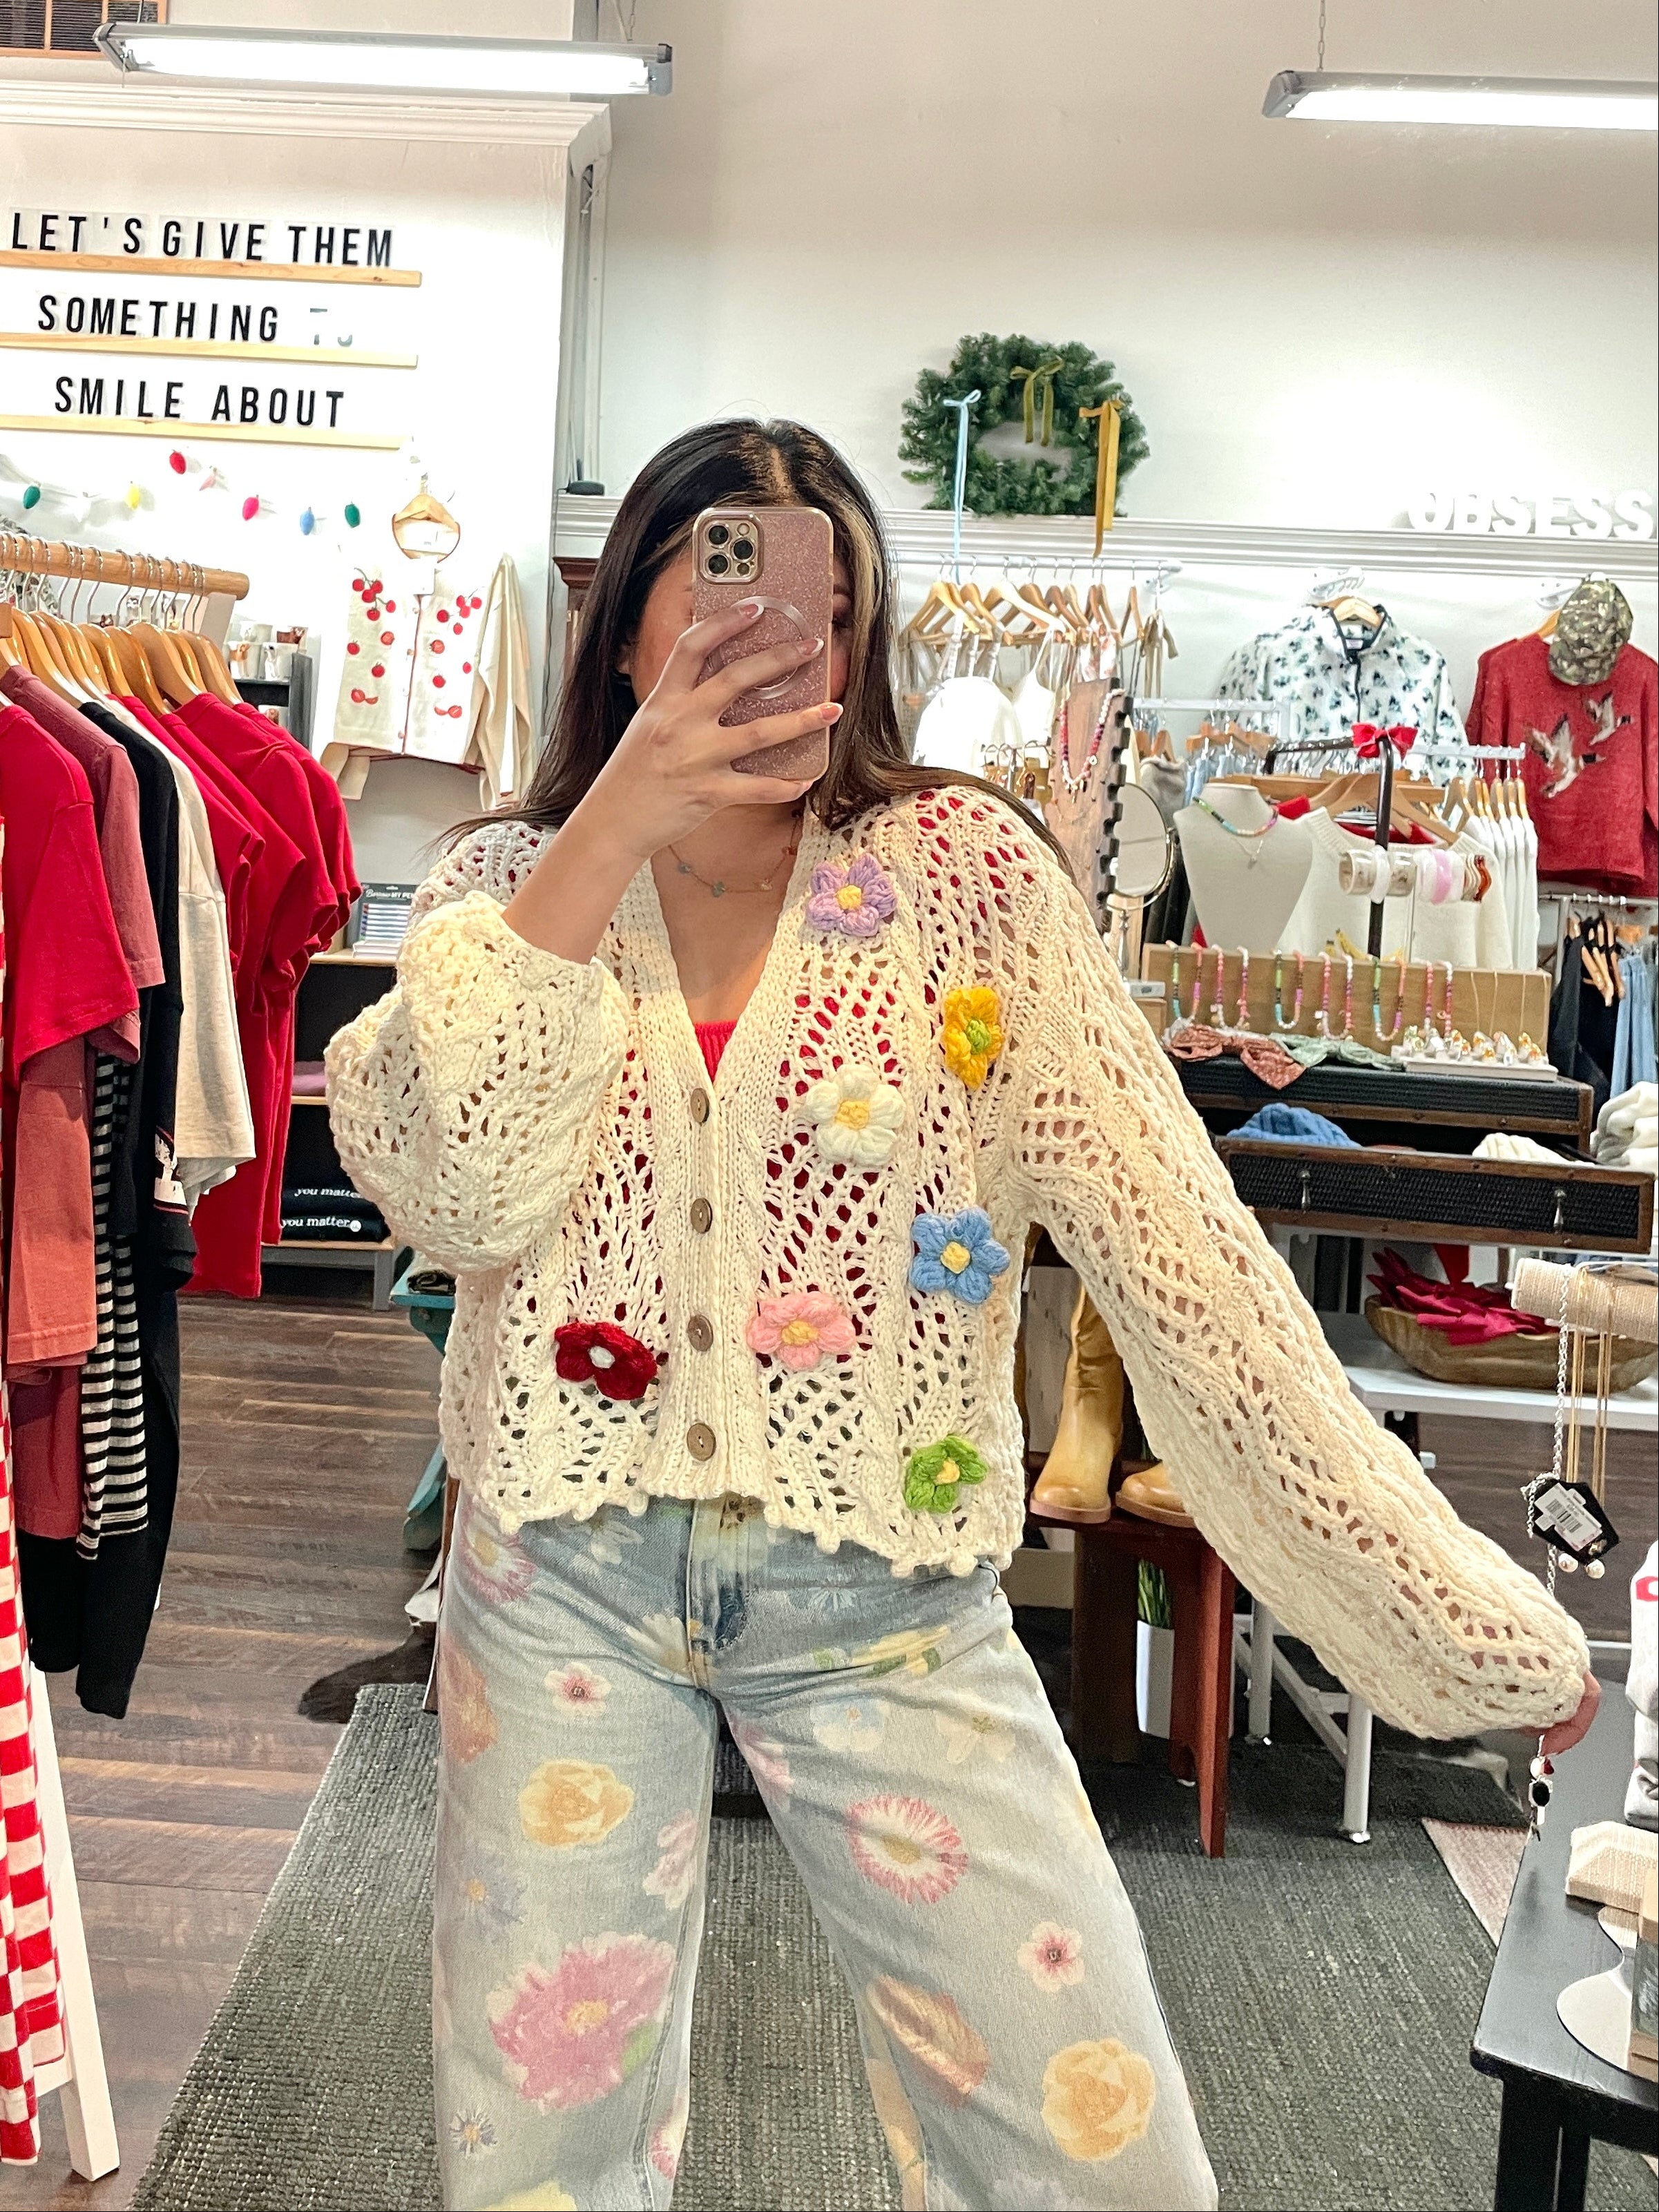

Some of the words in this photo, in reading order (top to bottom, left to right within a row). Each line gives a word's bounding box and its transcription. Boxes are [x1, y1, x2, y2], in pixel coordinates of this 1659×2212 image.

[12, 213, 142, 254] LET'S
[163, 220, 265, 261] GIVE
[288, 226, 392, 267] THEM
[38, 295, 278, 342] SOMETHING
[55, 376, 184, 419] SMILE
[211, 385, 344, 427] ABOUT
[1408, 488, 1655, 540] OBSESS
[294, 1188, 318, 1197] you
[320, 1188, 365, 1199] matte
[280, 1218, 303, 1229] you
